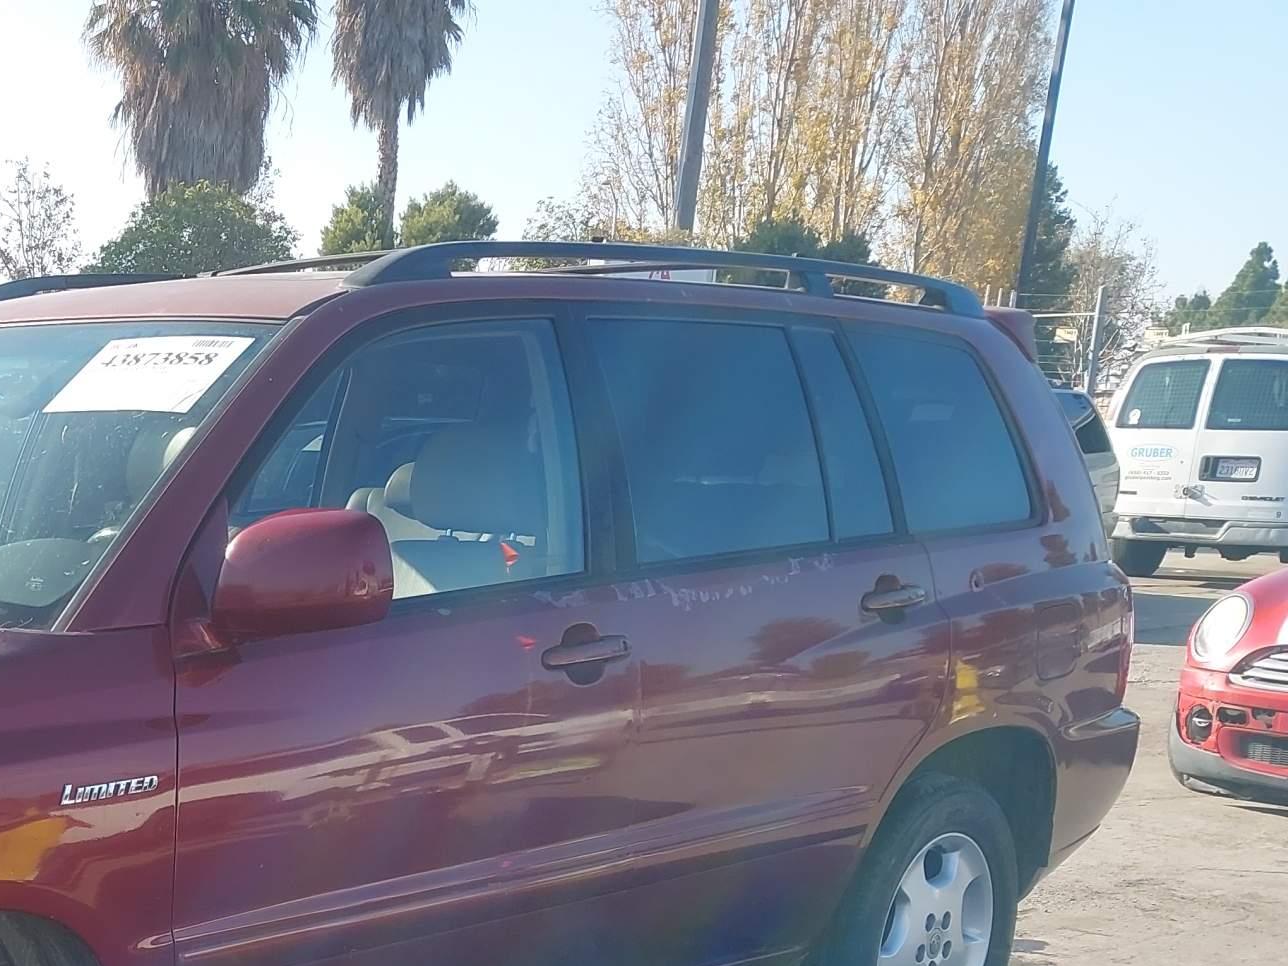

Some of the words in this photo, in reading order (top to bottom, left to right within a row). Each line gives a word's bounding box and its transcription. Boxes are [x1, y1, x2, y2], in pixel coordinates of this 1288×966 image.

[100, 352, 219, 368] 43873858
[1131, 447, 1173, 457] GRUBER
[59, 775, 159, 806] LIMITED
